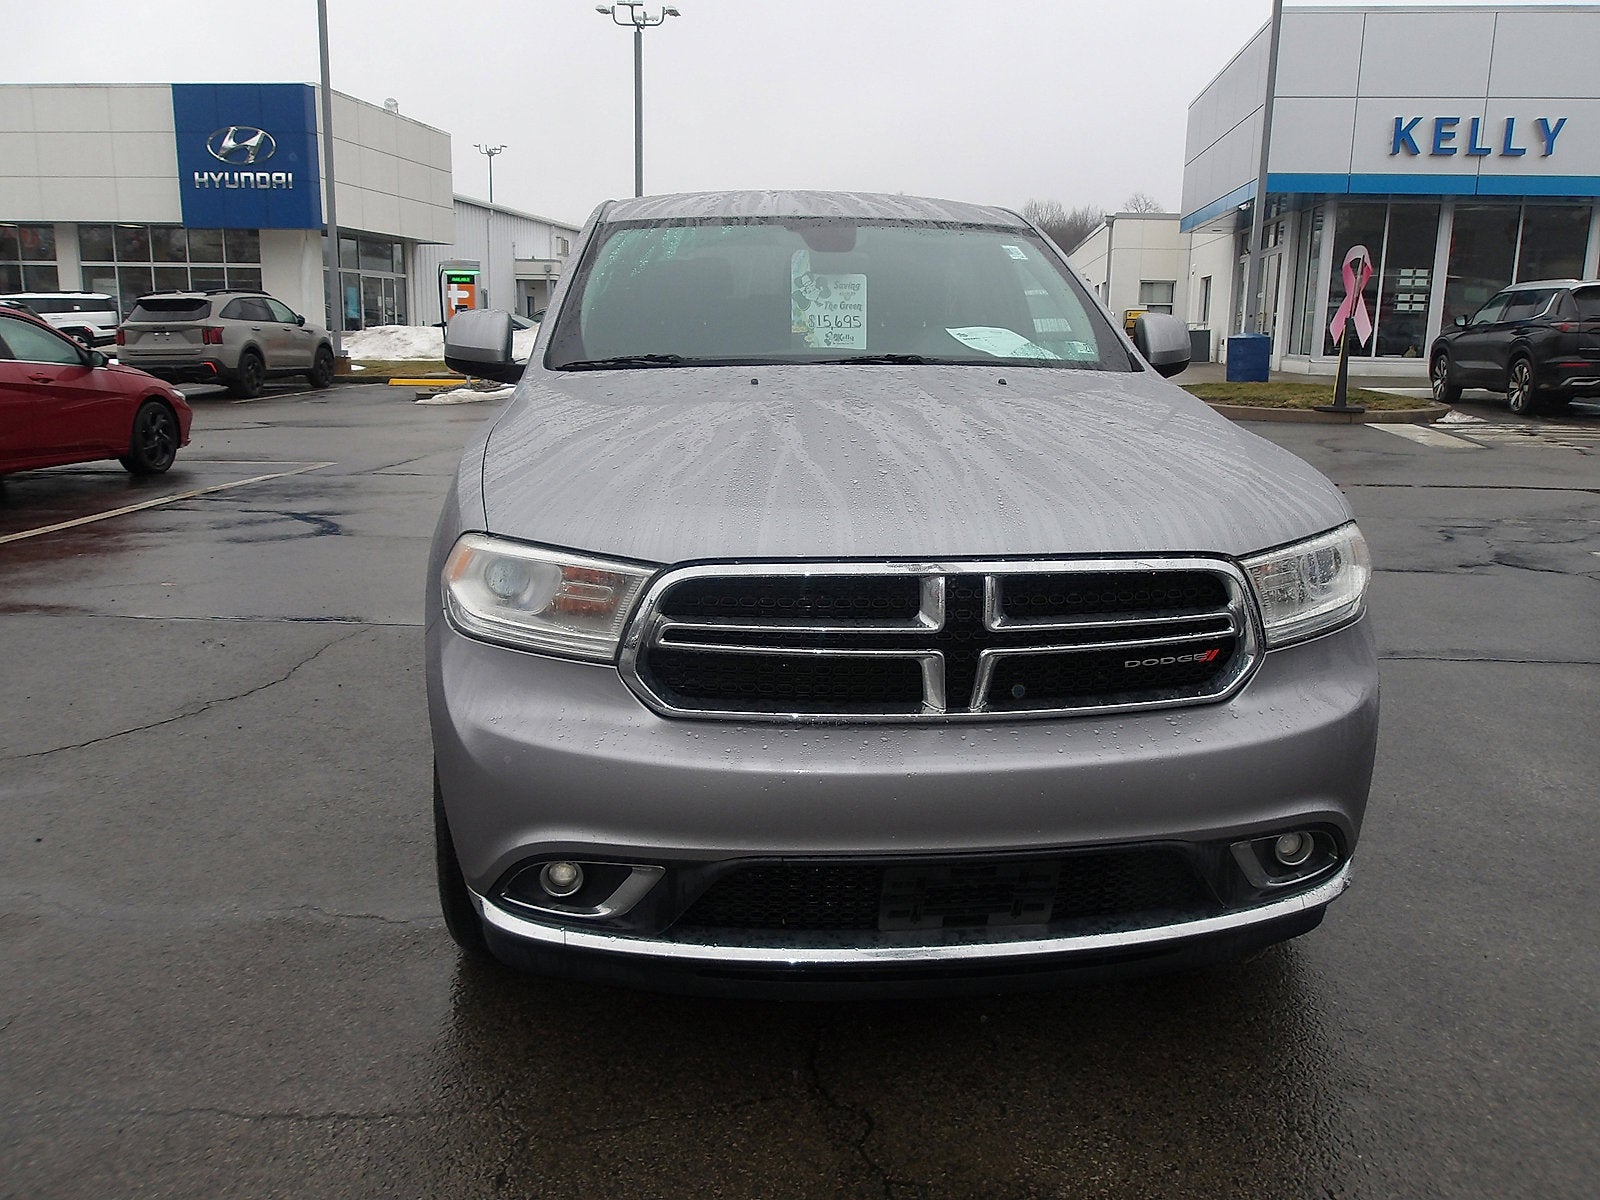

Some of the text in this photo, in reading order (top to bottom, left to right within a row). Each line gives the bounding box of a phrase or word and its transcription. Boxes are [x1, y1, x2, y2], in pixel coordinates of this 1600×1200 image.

[1389, 116, 1568, 157] KELLY
[193, 171, 293, 189] HYUNDAI
[834, 281, 861, 291] Saving
[824, 301, 863, 311] The Green
[808, 315, 862, 330] $15,695
[1124, 652, 1208, 668] DODGE
